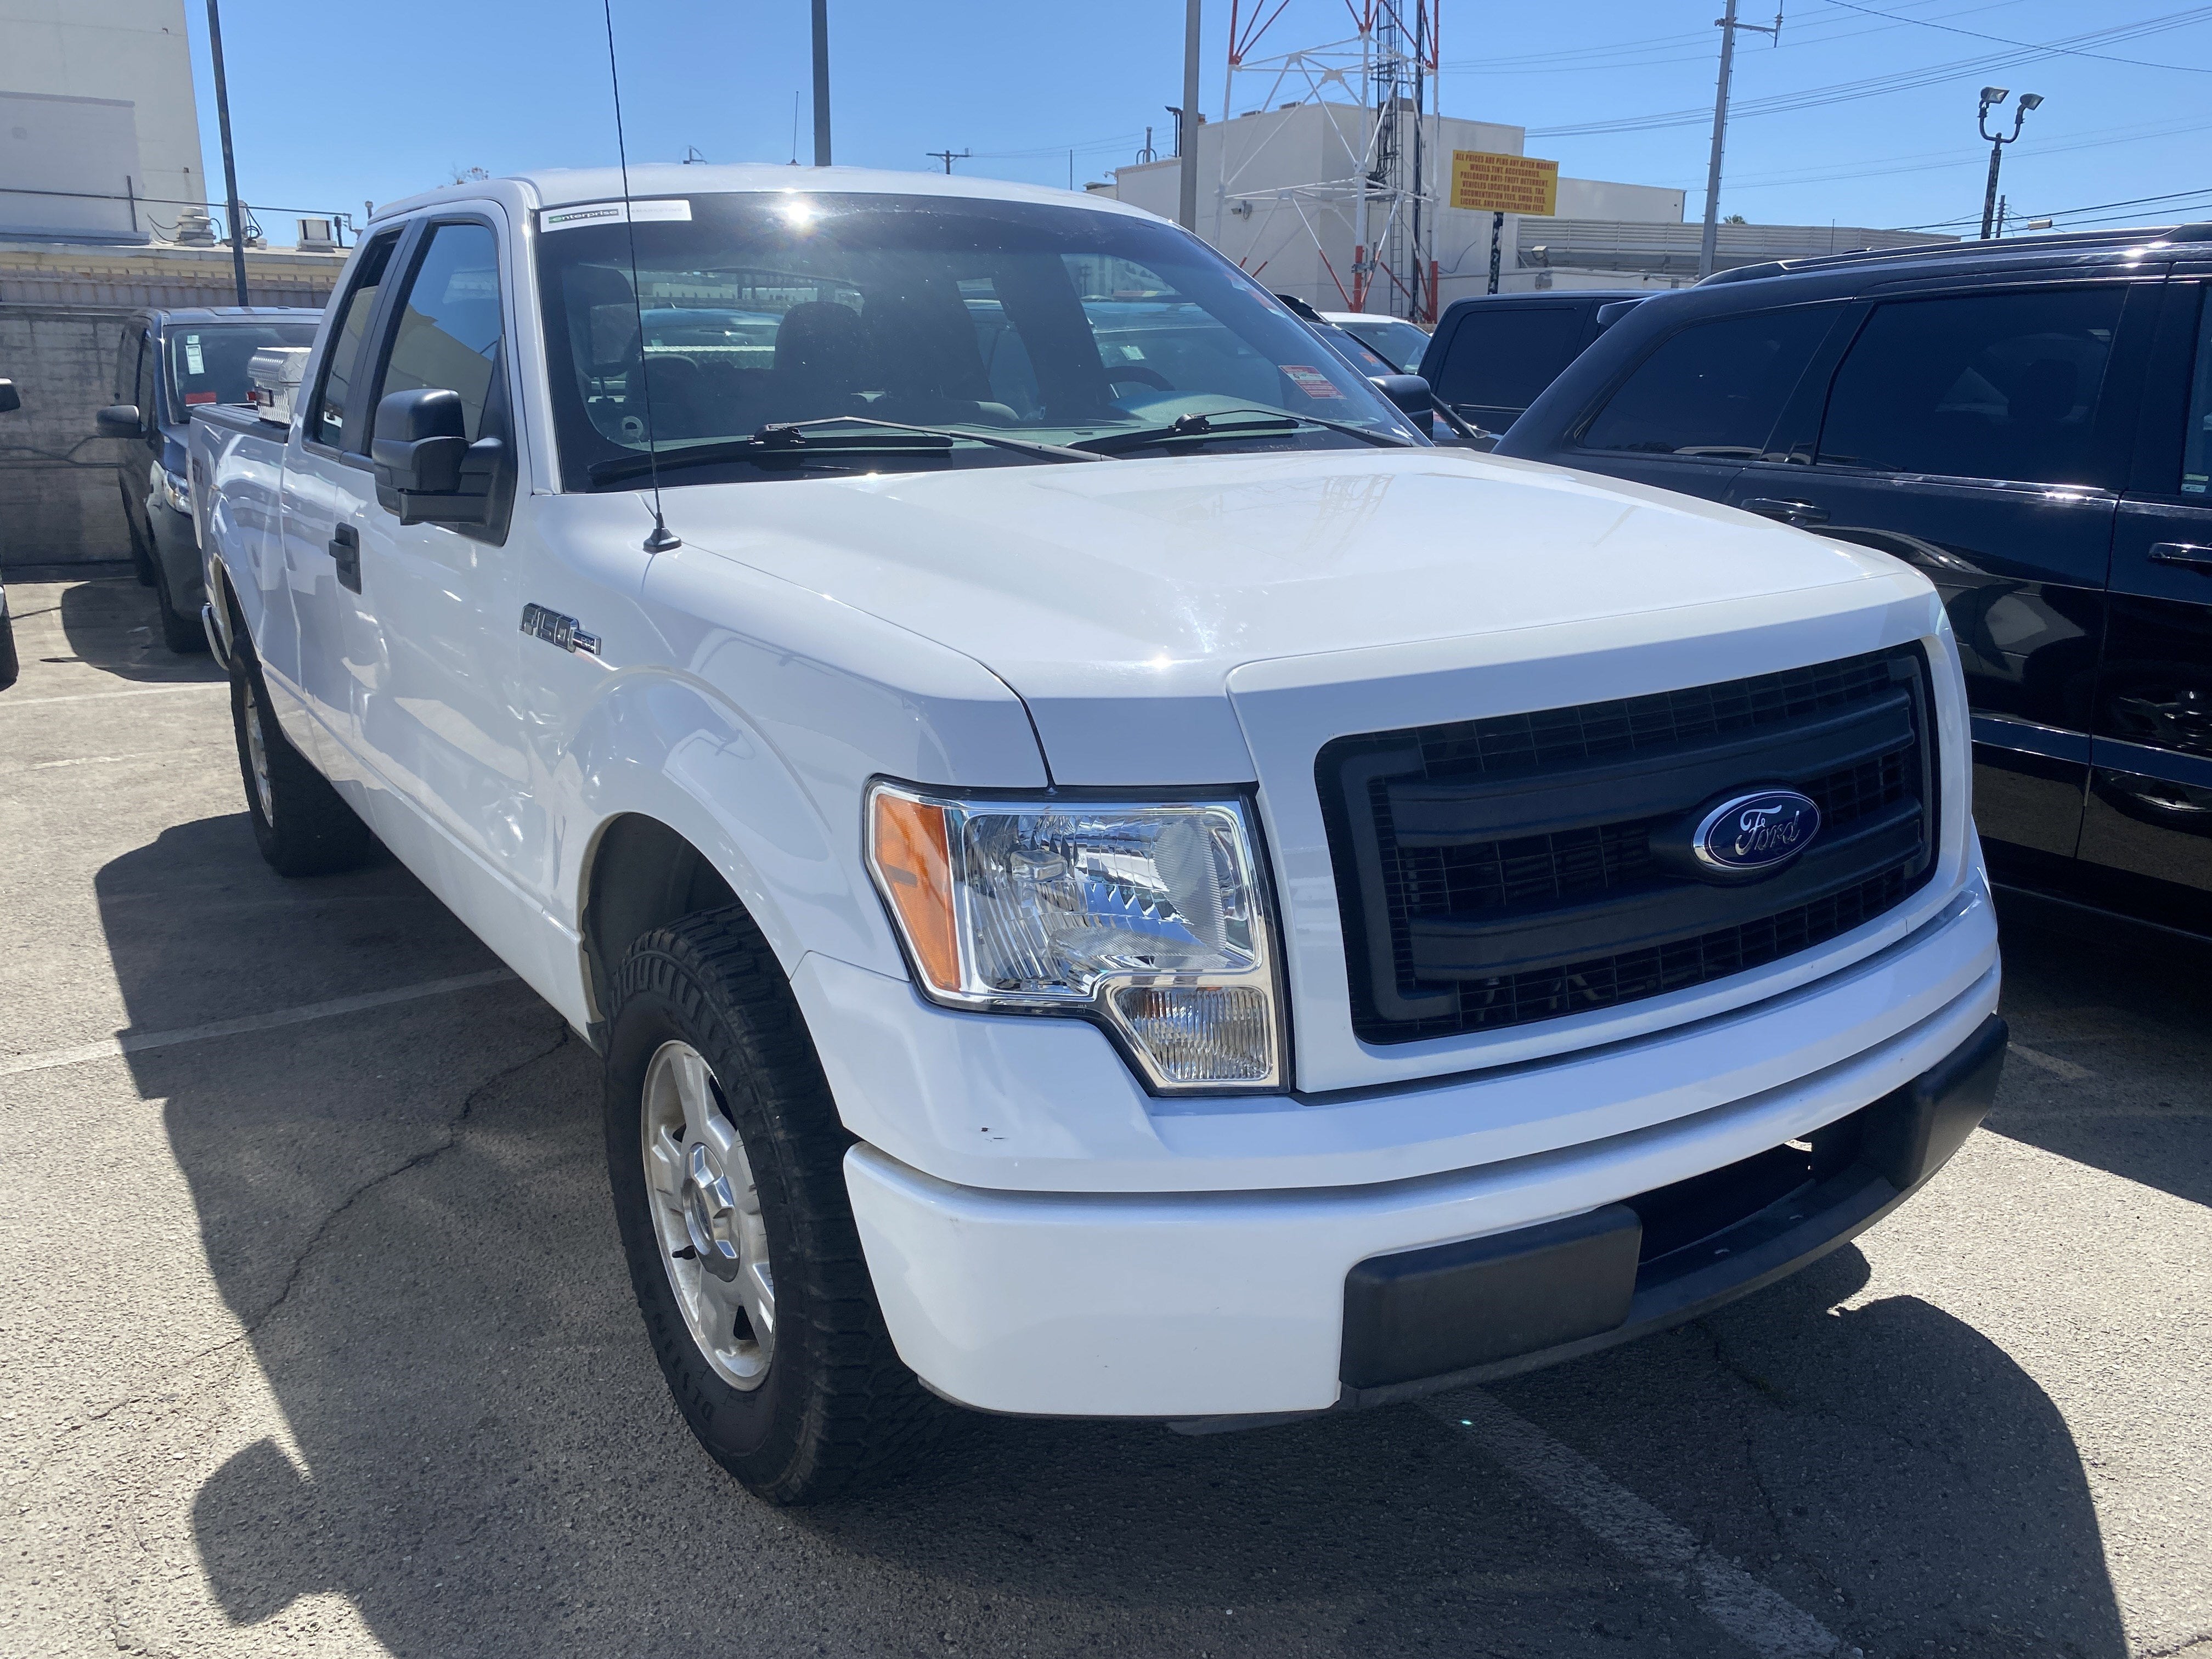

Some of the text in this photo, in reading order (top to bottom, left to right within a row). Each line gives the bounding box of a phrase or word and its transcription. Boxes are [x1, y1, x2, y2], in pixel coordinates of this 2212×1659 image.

[1465, 154, 1484, 163] PRICES
[1496, 157, 1508, 166] PLUS
[1520, 160, 1535, 168] AFTER
[1536, 162, 1556, 171] MARKET
[1462, 180, 1486, 189] VEHICLES
[1488, 183, 1510, 191] LOCATOR
[1505, 176, 1519, 184] THEFT
[1460, 189, 1503, 199] DOCUMENTATION
[1518, 194, 1532, 202] SMOG
[1496, 201, 1531, 211] REGISTRATION
[549, 210, 618, 222] enterprise
[1735, 805, 1800, 856] Ford
